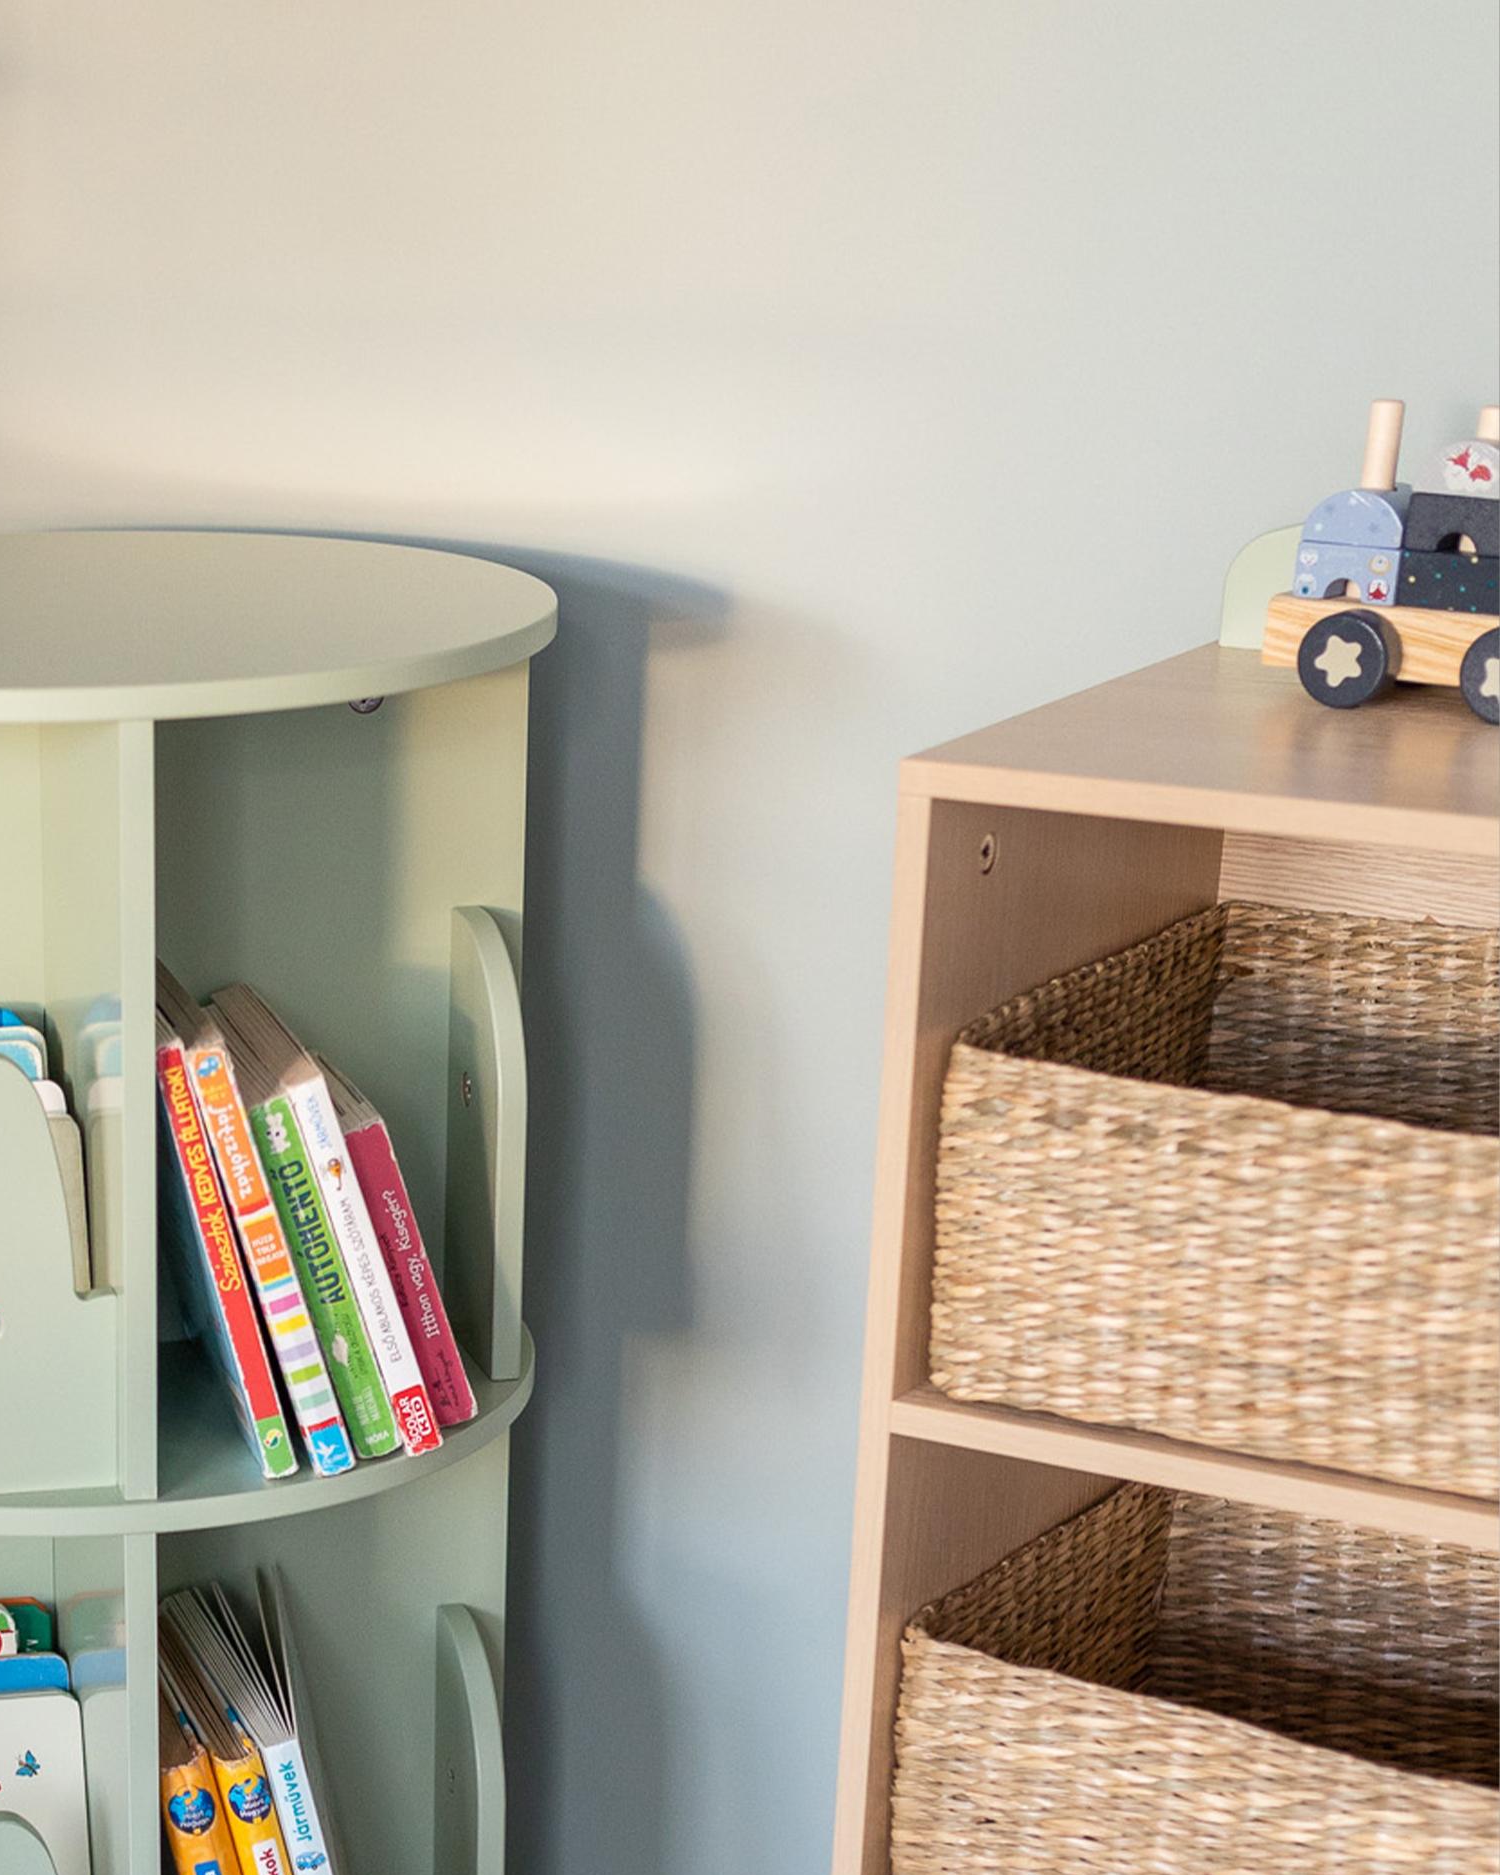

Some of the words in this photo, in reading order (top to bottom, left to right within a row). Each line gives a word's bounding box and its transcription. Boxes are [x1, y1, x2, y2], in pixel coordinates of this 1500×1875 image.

[164, 1067, 200, 1141] ÁLLATOK!
[186, 1144, 219, 1205] KEDVES
[207, 1103, 253, 1199] játszóház
[200, 1208, 241, 1292] Sziasztok,
[270, 1160, 346, 1305] AUTÓMENTŐ
[357, 1252, 375, 1287] KÉPES
[368, 1288, 391, 1333] ABLAKOS
[418, 1294, 440, 1338] Itthon
[399, 1396, 423, 1445] SCOLAR
[413, 1399, 430, 1432] KID
[279, 1760, 312, 1842] Járművek
